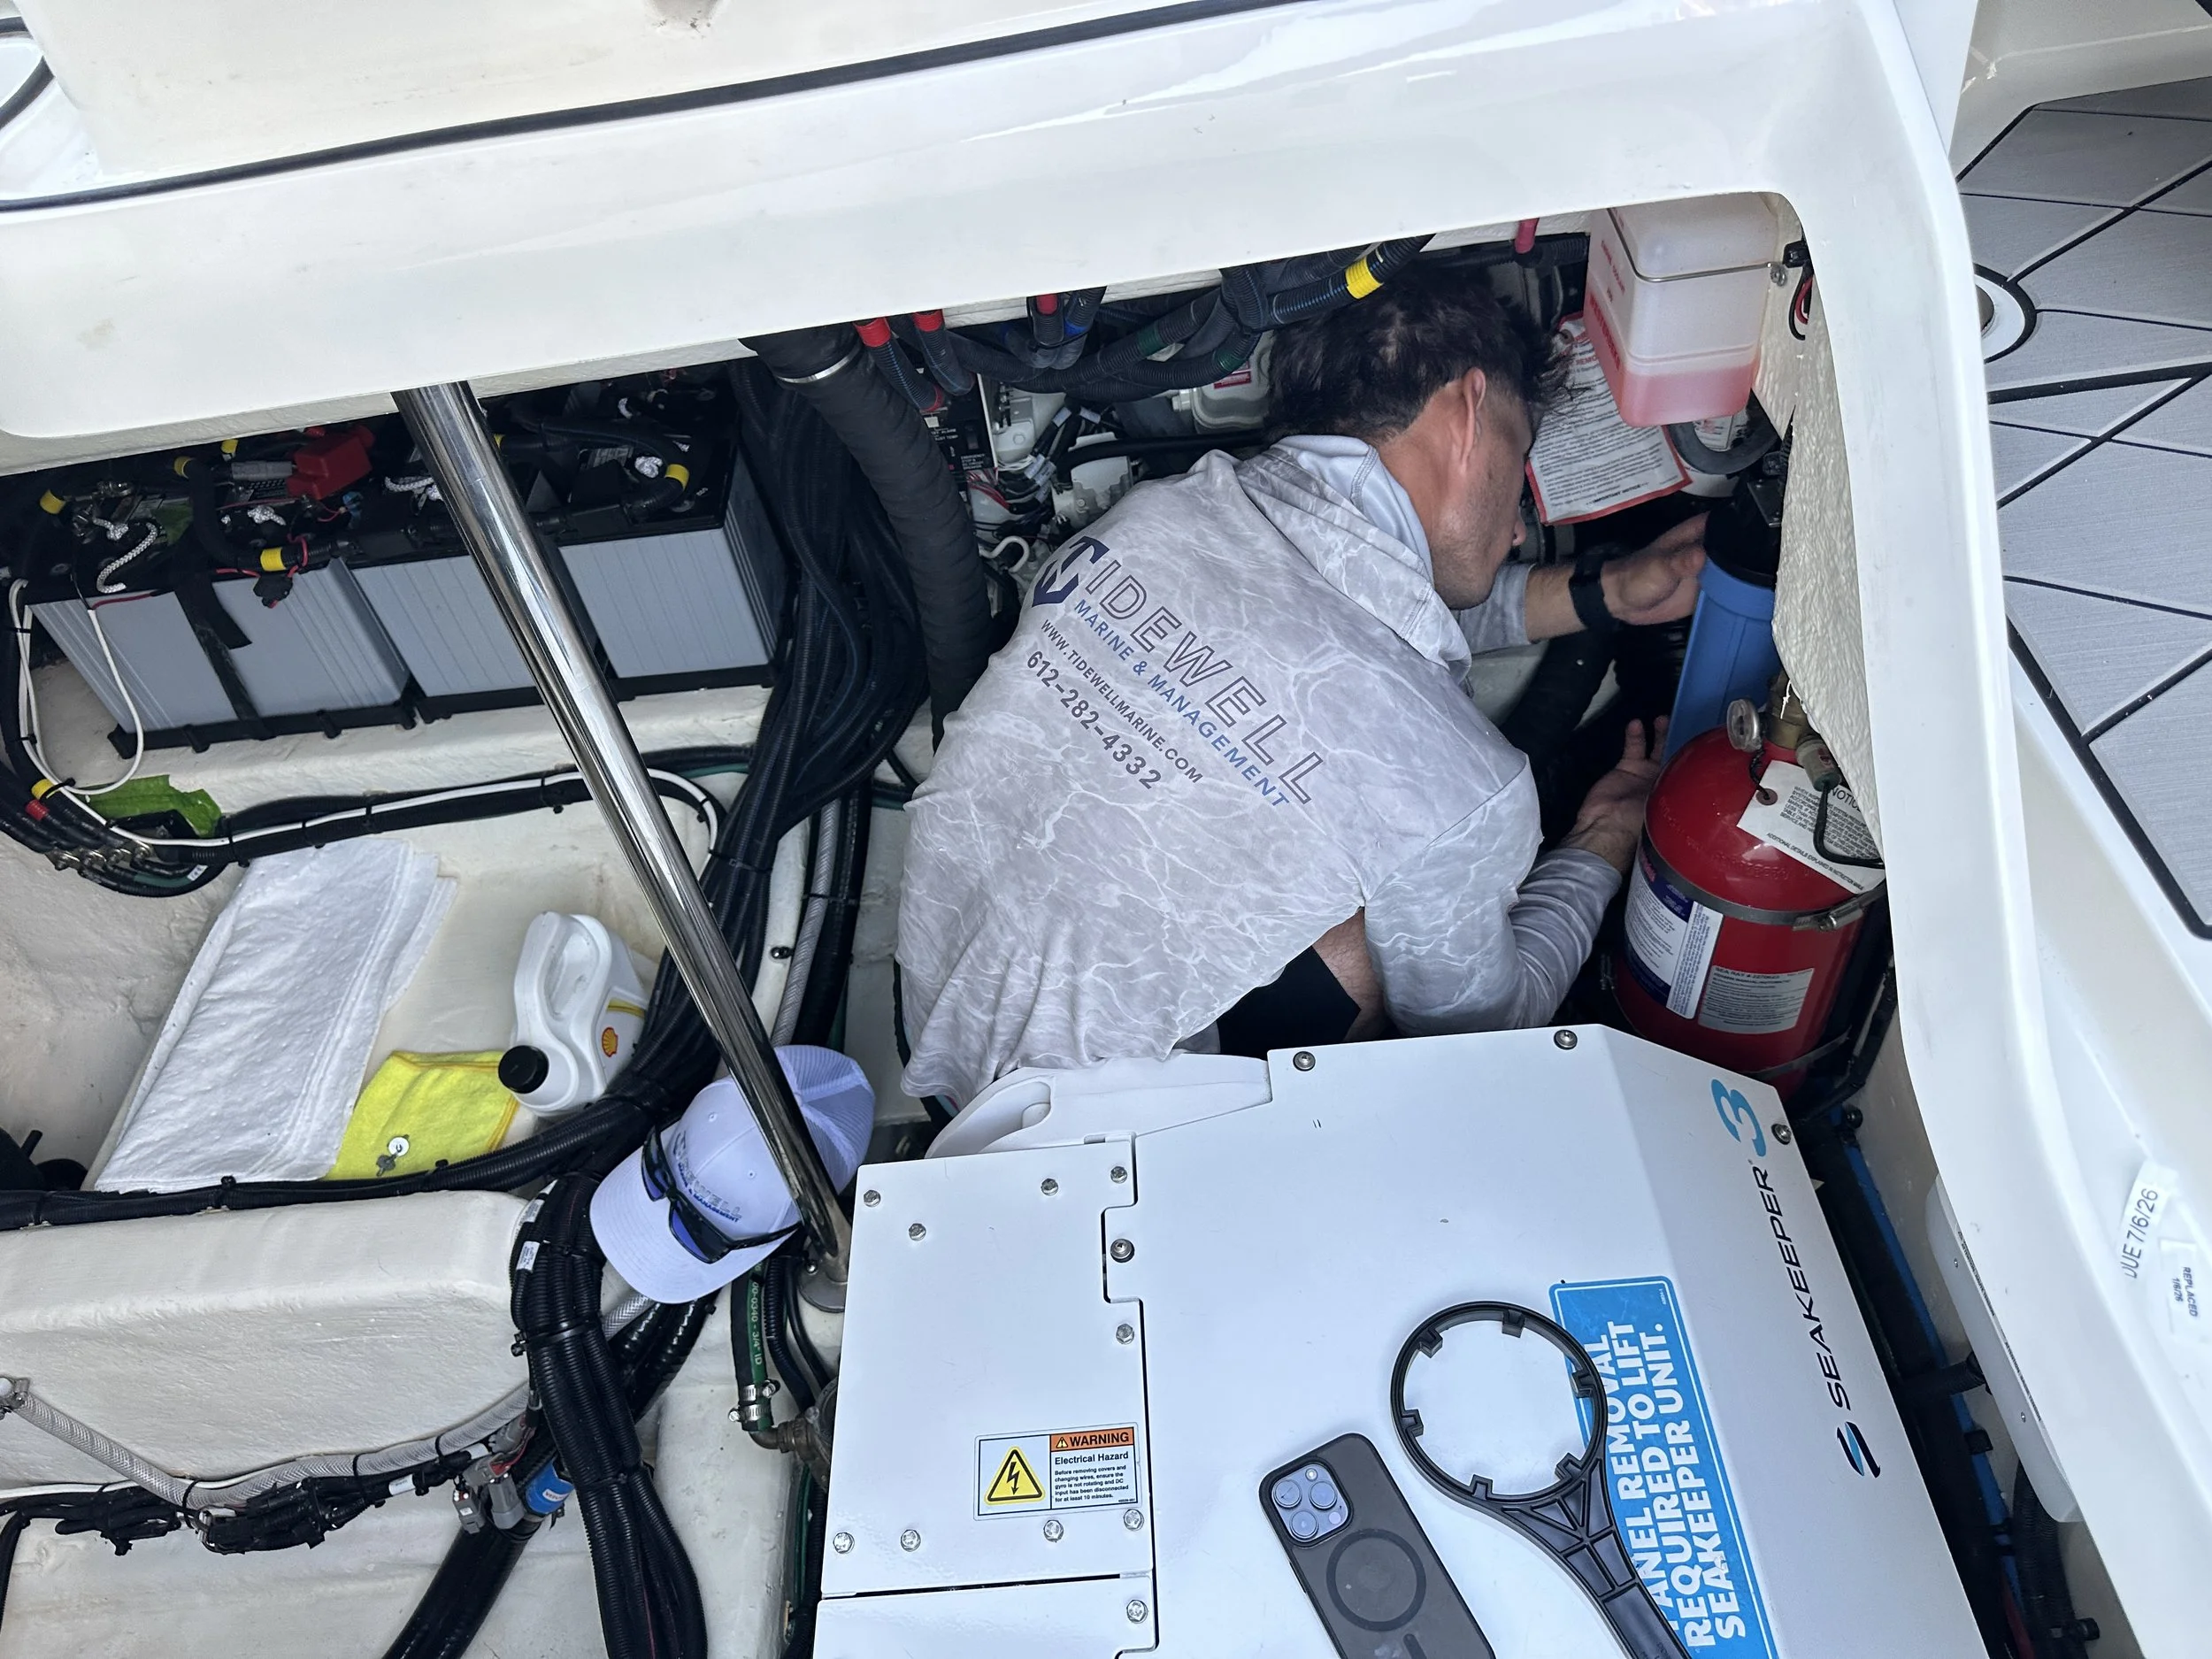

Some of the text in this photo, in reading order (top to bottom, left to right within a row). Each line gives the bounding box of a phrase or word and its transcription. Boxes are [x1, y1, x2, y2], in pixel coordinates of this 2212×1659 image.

[1026, 650, 1163, 789] 612-282-4332
[1040, 618, 1203, 784] WWW.TIDEWELLMARINE.COM
[1075, 599, 1290, 807] MARINE & MANAGEMENT
[1831, 787, 1861, 811] NOTIC
[1711, 1078, 1766, 1157] 3
[2121, 1188, 2158, 1279] DUE 7/6/26
[1752, 1164, 1851, 1411] SEAKEEPER
[2183, 1266, 2198, 1317] REPLACED
[755, 1354, 763, 1366] ID
[1607, 1321, 1648, 1386] LIFT
[1055, 1451, 1129, 1465] Electrical Hazard
[1070, 1432, 1129, 1448] WARNING
[1627, 1394, 1663, 1440] TO
[1640, 1323, 1746, 1640] SEAKEEPER UNIT.
[1622, 1506, 1678, 1631] ANEL
[1640, 1452, 1716, 1647] REQUIRED
